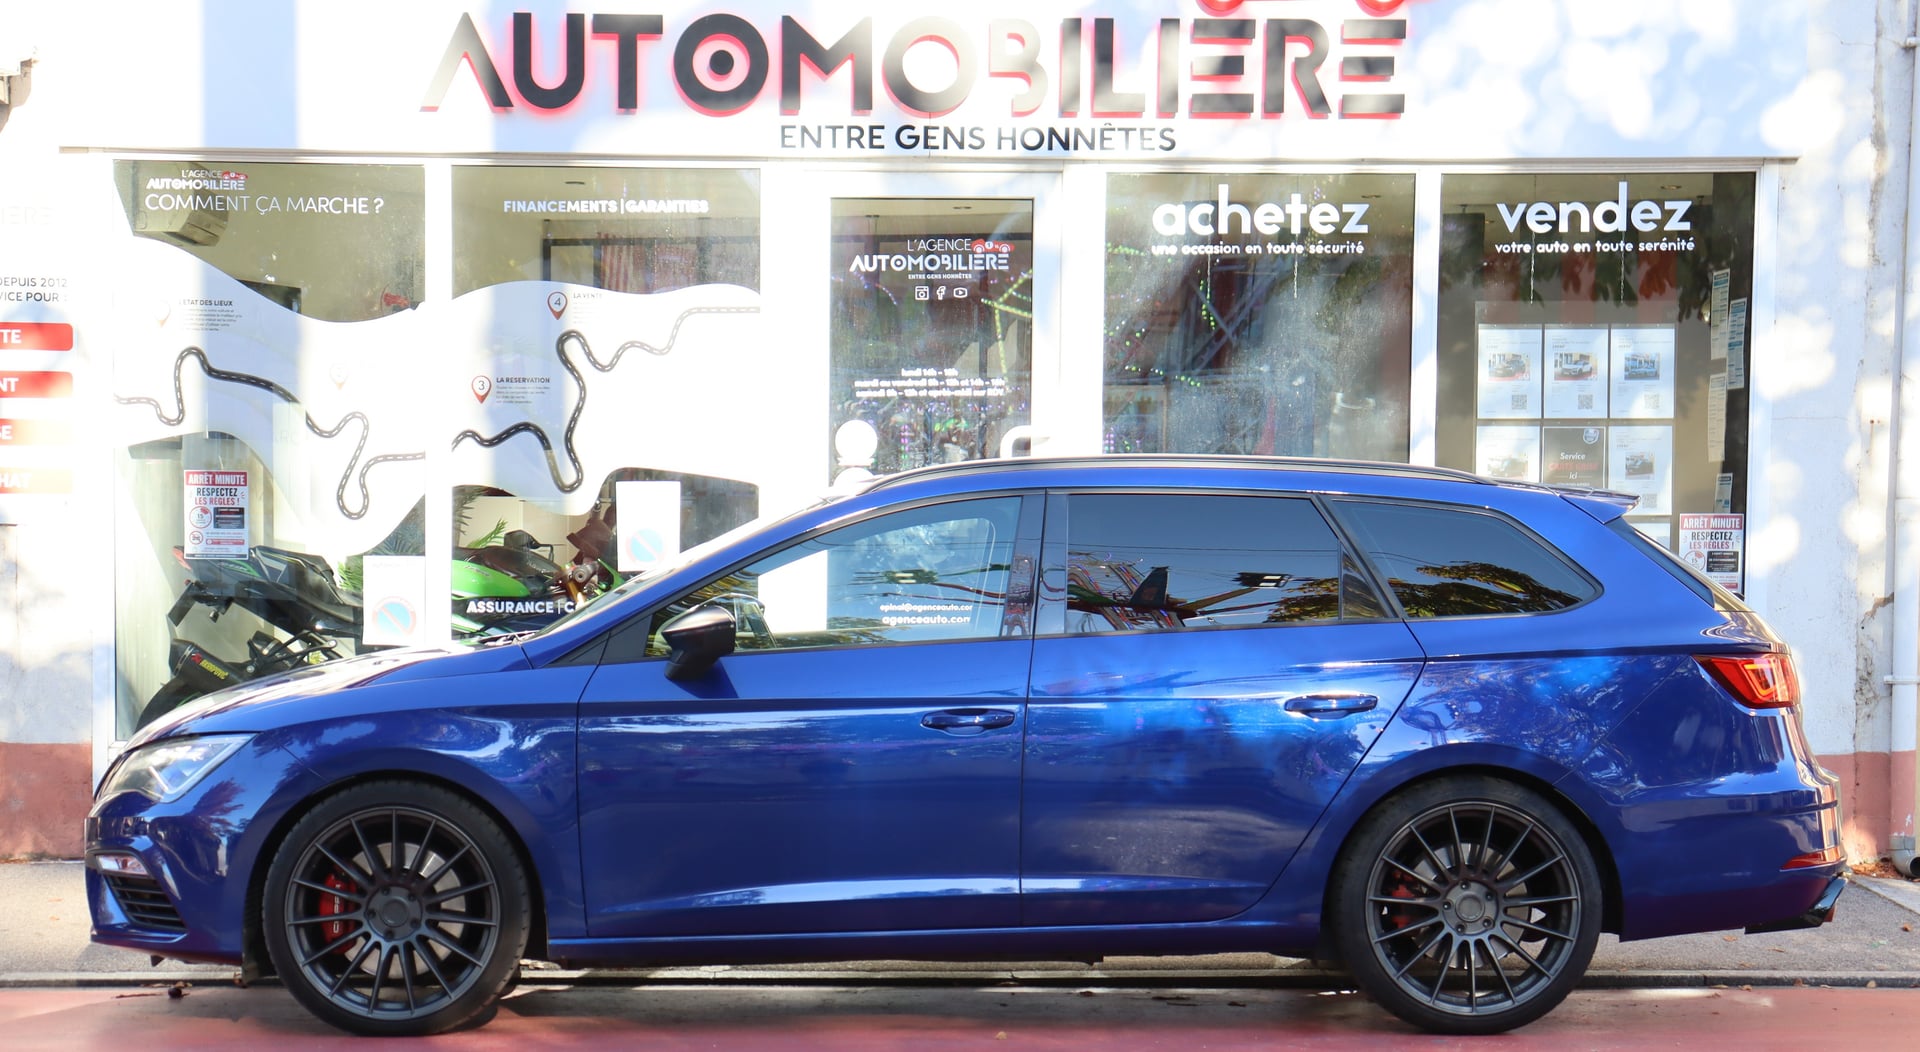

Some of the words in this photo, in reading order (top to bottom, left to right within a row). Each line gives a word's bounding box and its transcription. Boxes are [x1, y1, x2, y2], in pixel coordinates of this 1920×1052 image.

[780, 124, 885, 150] ENTRE
[895, 124, 985, 151] GENS
[997, 122, 1177, 152] HONNÊTES
[145, 194, 250, 213] COMMENT
[255, 196, 282, 216] ÇA
[287, 197, 369, 215] MARCHE
[373, 198, 384, 215] ?
[503, 200, 618, 214] FINANCEMENTS
[625, 200, 709, 214] GARANTIES
[1152, 184, 1370, 237] achetez
[1496, 181, 1692, 233] vendez
[907, 239, 972, 252] L'AGENCE
[1152, 244, 1178, 256] une
[1181, 241, 1240, 255] occasion
[1244, 244, 1262, 255] en
[1266, 241, 1303, 255] toute
[1308, 239, 1365, 254] sécurité
[1495, 242, 1532, 254] votre
[1536, 241, 1569, 254] auto
[1573, 243, 1591, 254] en
[1595, 240, 1633, 253] toute
[40, 277, 67, 288] 2012
[25, 291, 60, 302] POUR
[1559, 452, 1586, 461] Service
[188, 472, 213, 485] ARRÊT
[215, 474, 245, 485] MINUTE
[196, 487, 238, 497] RESPECTEZ
[195, 497, 207, 505] LES
[1683, 516, 1709, 529] ARRÊT
[1710, 517, 1740, 529] MINUTE
[1691, 531, 1733, 541] RESPECTEZ
[1690, 541, 1702, 550] LES
[466, 600, 554, 614] ASSURANCE
